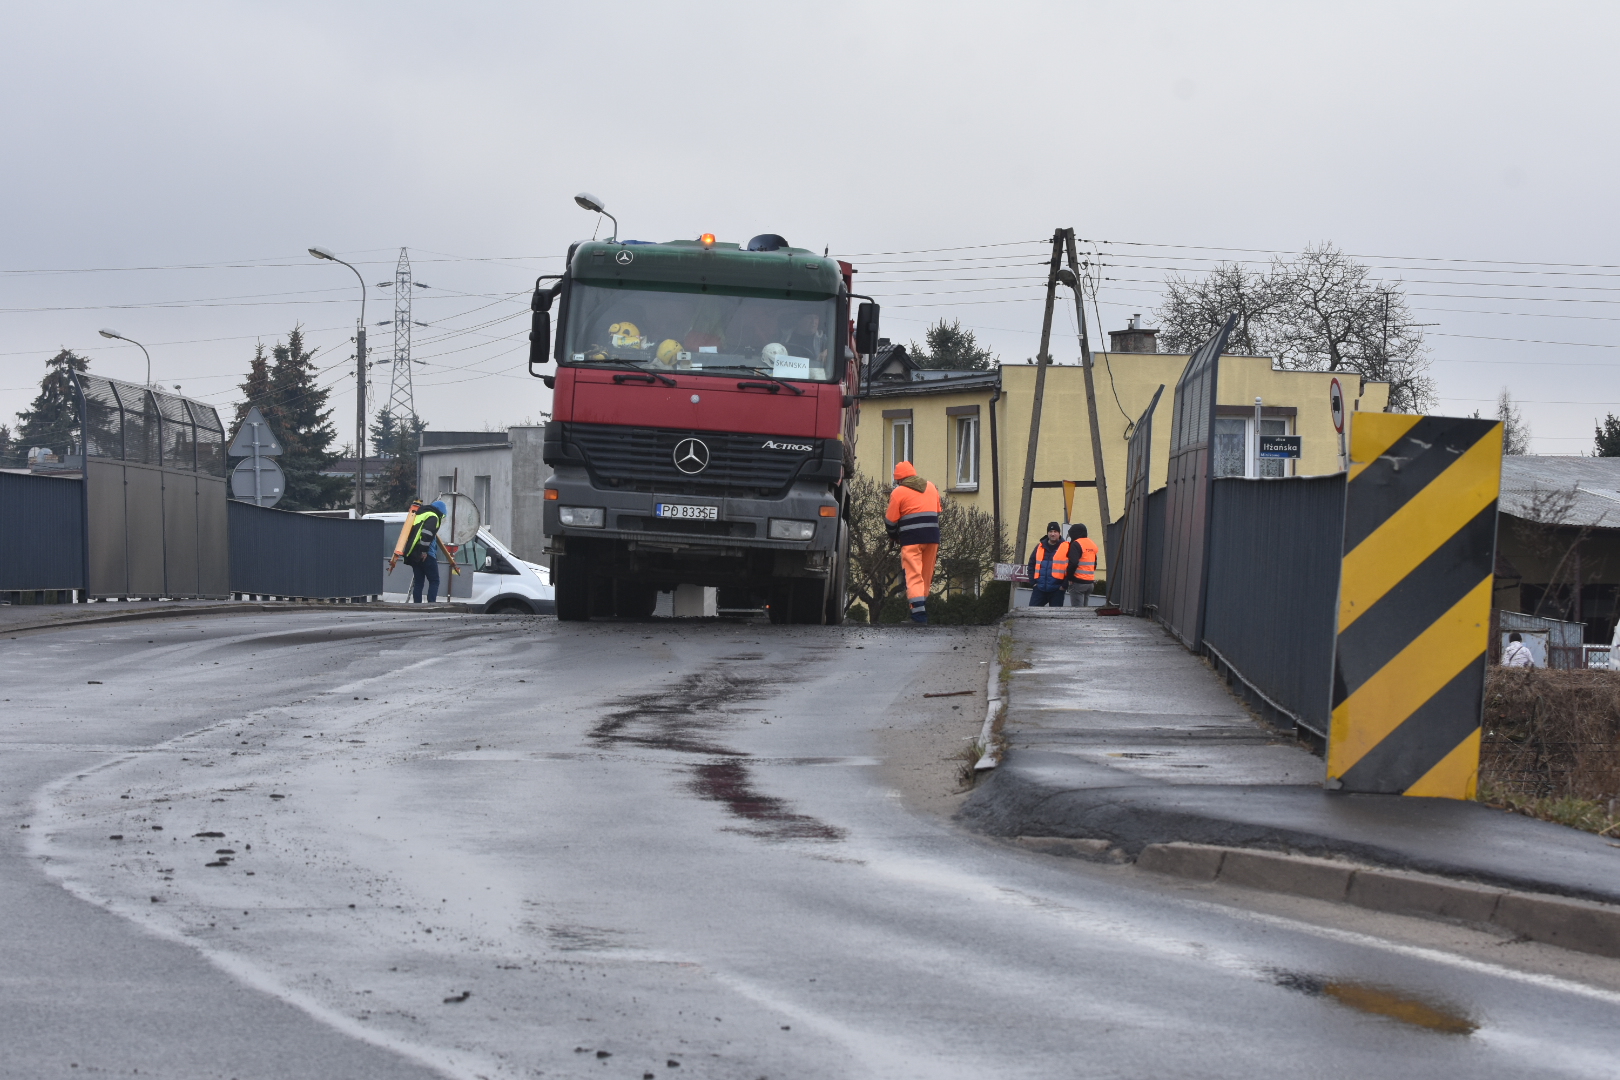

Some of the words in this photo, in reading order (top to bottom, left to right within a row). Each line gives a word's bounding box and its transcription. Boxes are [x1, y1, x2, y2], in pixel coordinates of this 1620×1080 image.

[775, 360, 807, 369] SKANSKA
[1263, 443, 1298, 451] Iłżańska
[682, 506, 717, 519] 833SE
[996, 563, 1029, 576] FRYZJE
